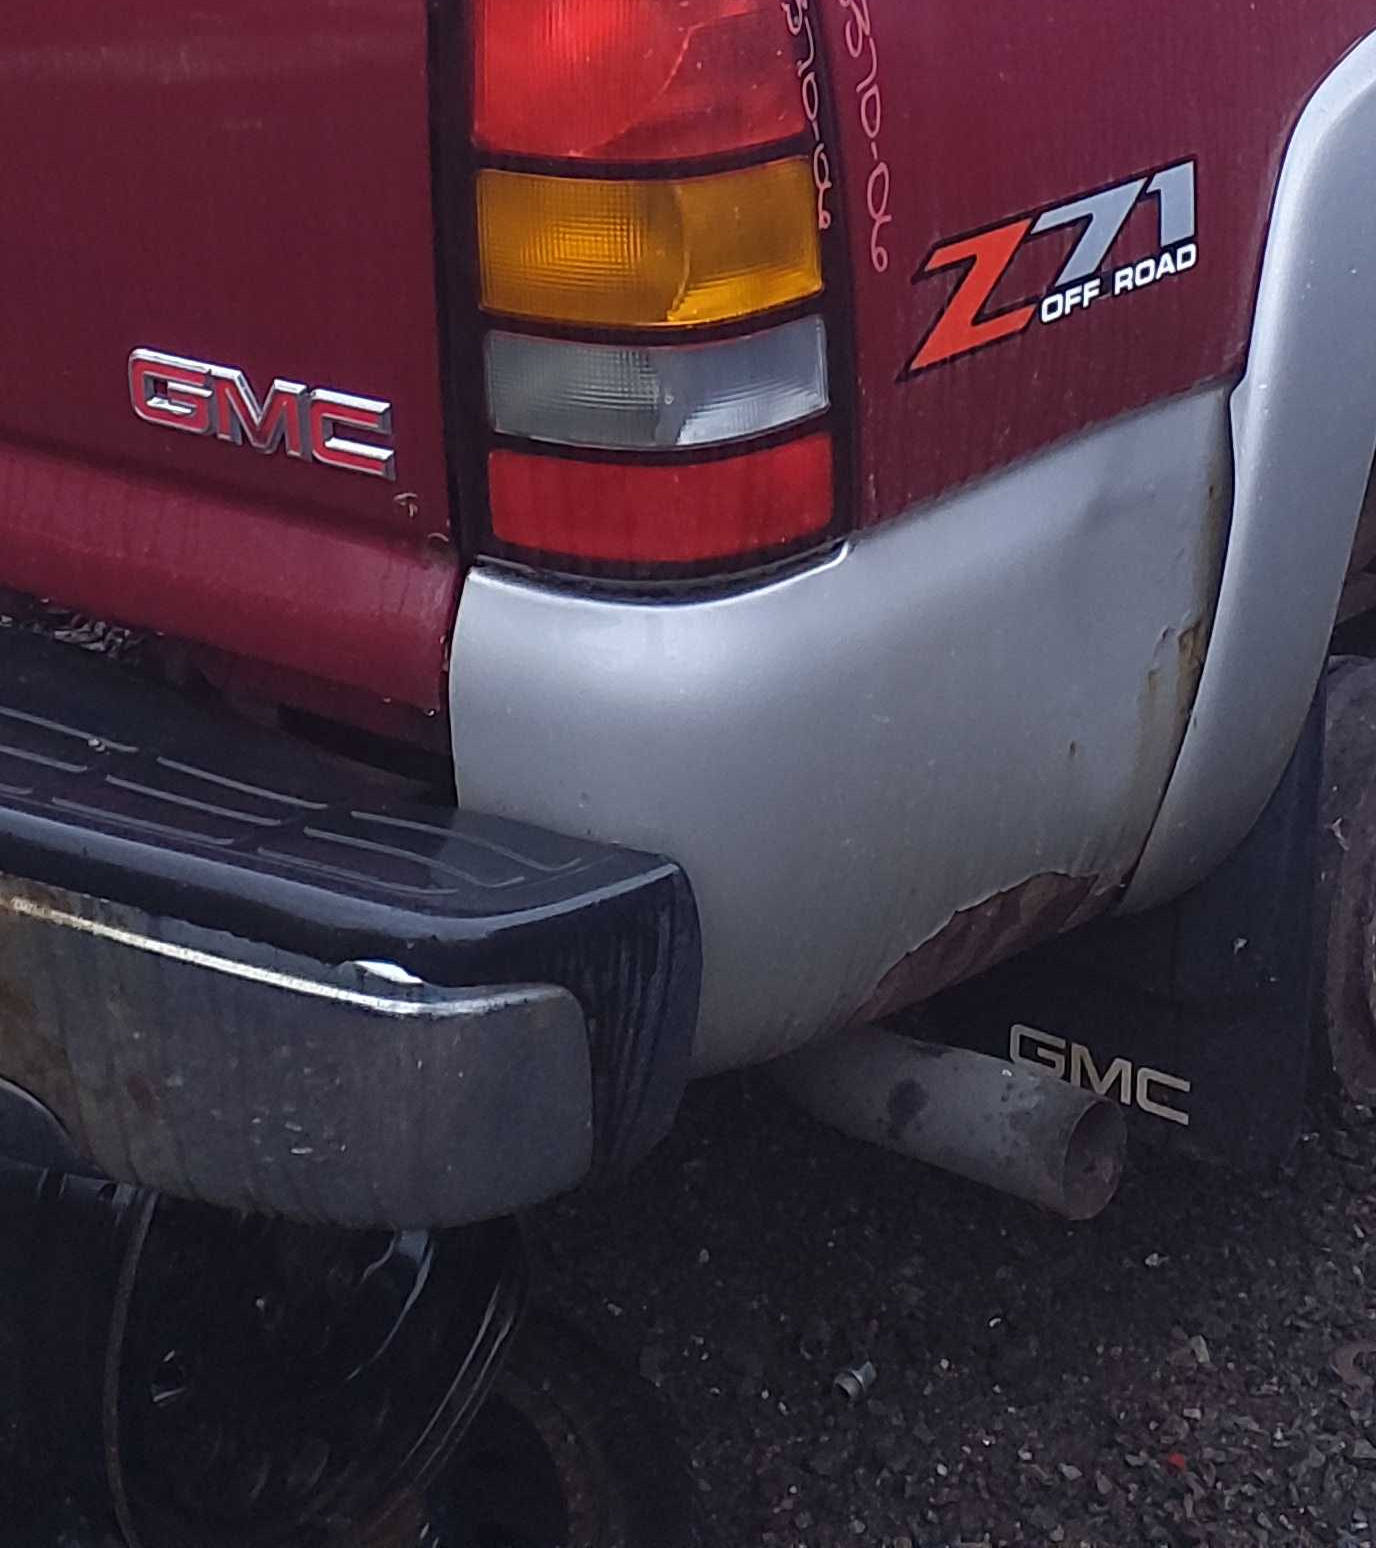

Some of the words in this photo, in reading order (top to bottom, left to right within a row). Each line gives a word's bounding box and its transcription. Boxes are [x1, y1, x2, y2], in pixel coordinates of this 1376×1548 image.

[902, 155, 1198, 378] Z71
[1039, 279, 1101, 324] OFF
[1113, 243, 1198, 296] ROAD
[127, 348, 396, 482] GMC
[1009, 1024, 1191, 1127] GMC
